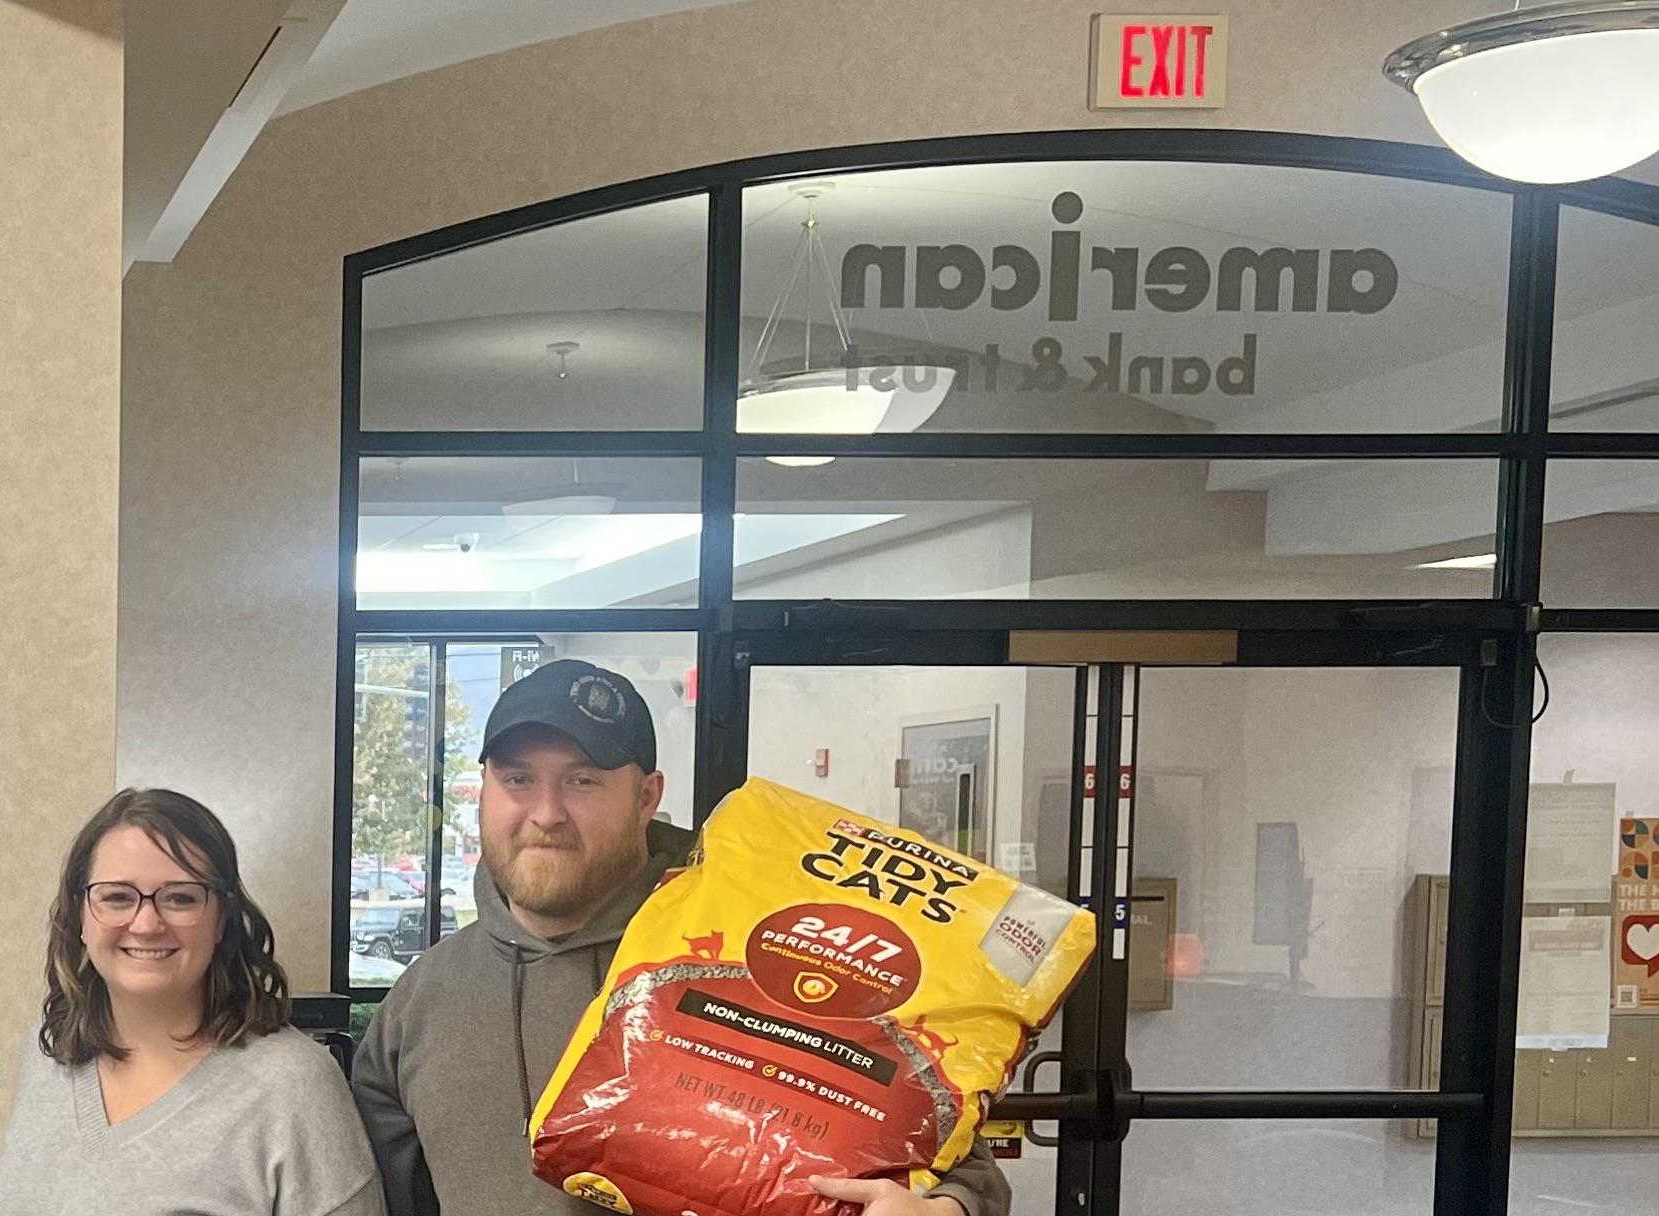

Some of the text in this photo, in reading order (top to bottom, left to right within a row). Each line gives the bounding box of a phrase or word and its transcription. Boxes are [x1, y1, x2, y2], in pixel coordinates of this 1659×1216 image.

[1119, 25, 1213, 100] EXIT
[1084, 773, 1095, 789] 6
[1119, 773, 1131, 789] 6
[826, 831, 968, 896] TIDY
[868, 829, 971, 878] PURINA
[801, 853, 958, 924] CATS
[1619, 898, 1646, 911] THE
[1620, 884, 1646, 897] THE
[1003, 914, 1047, 948] POWERFUL
[1114, 904, 1126, 921] 5
[761, 930, 903, 987] PERFORMANCE
[791, 916, 903, 963] 24/7
[995, 928, 1037, 964] CONTROL
[998, 921, 1042, 955] ODOR
[760, 942, 894, 996] Continuous Odor Control
[703, 1001, 874, 1069] NON-CLUMPING LITTER
[665, 1034, 886, 1122] LOW TRACKING 99.9% DUST FREE
[676, 1072, 701, 1092] NET
[702, 1081, 727, 1099] WT
[748, 1094, 765, 1115] LB
